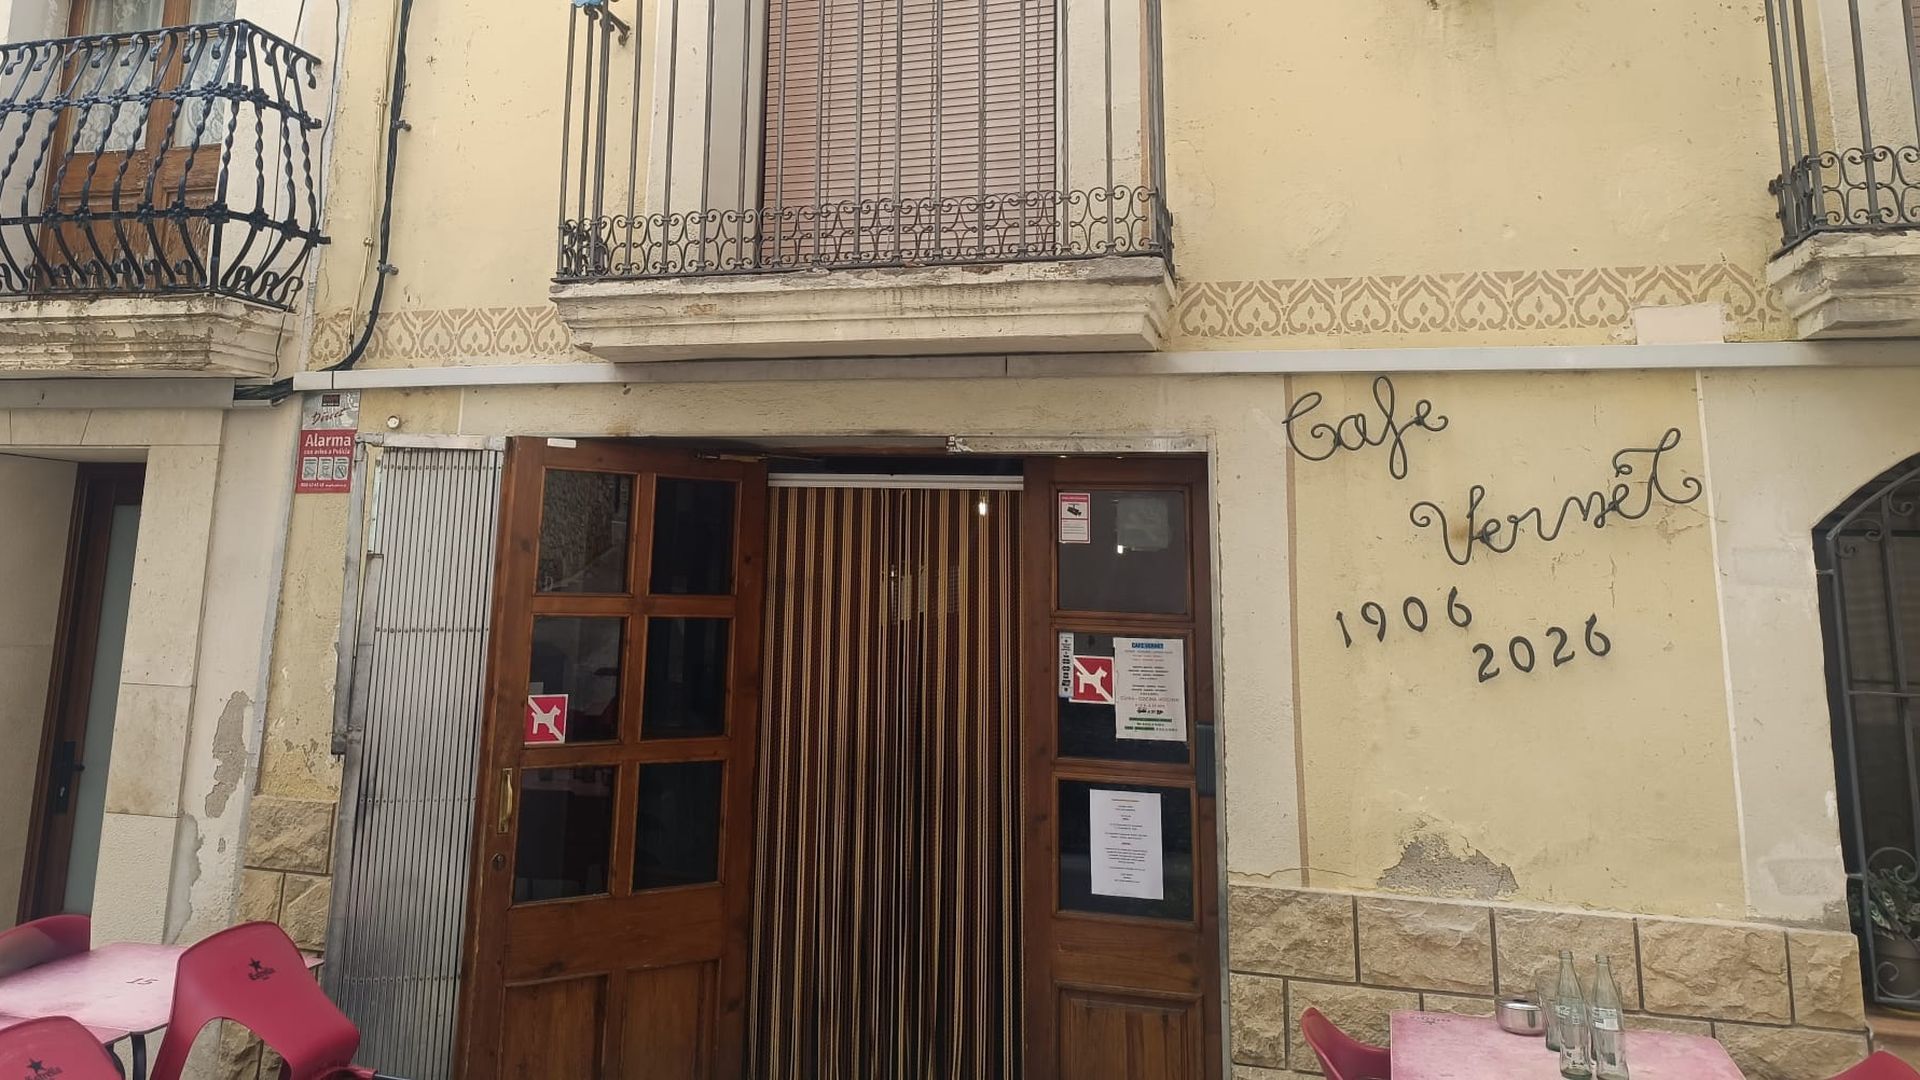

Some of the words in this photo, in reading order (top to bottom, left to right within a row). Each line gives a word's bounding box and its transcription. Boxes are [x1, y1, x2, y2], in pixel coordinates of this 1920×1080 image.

[305, 433, 351, 447] Alarma
[1283, 375, 1448, 480] Cafe
[1410, 428, 1702, 566] Vernet
[1336, 586, 1473, 648] 1906
[1472, 613, 1612, 683] 2026
